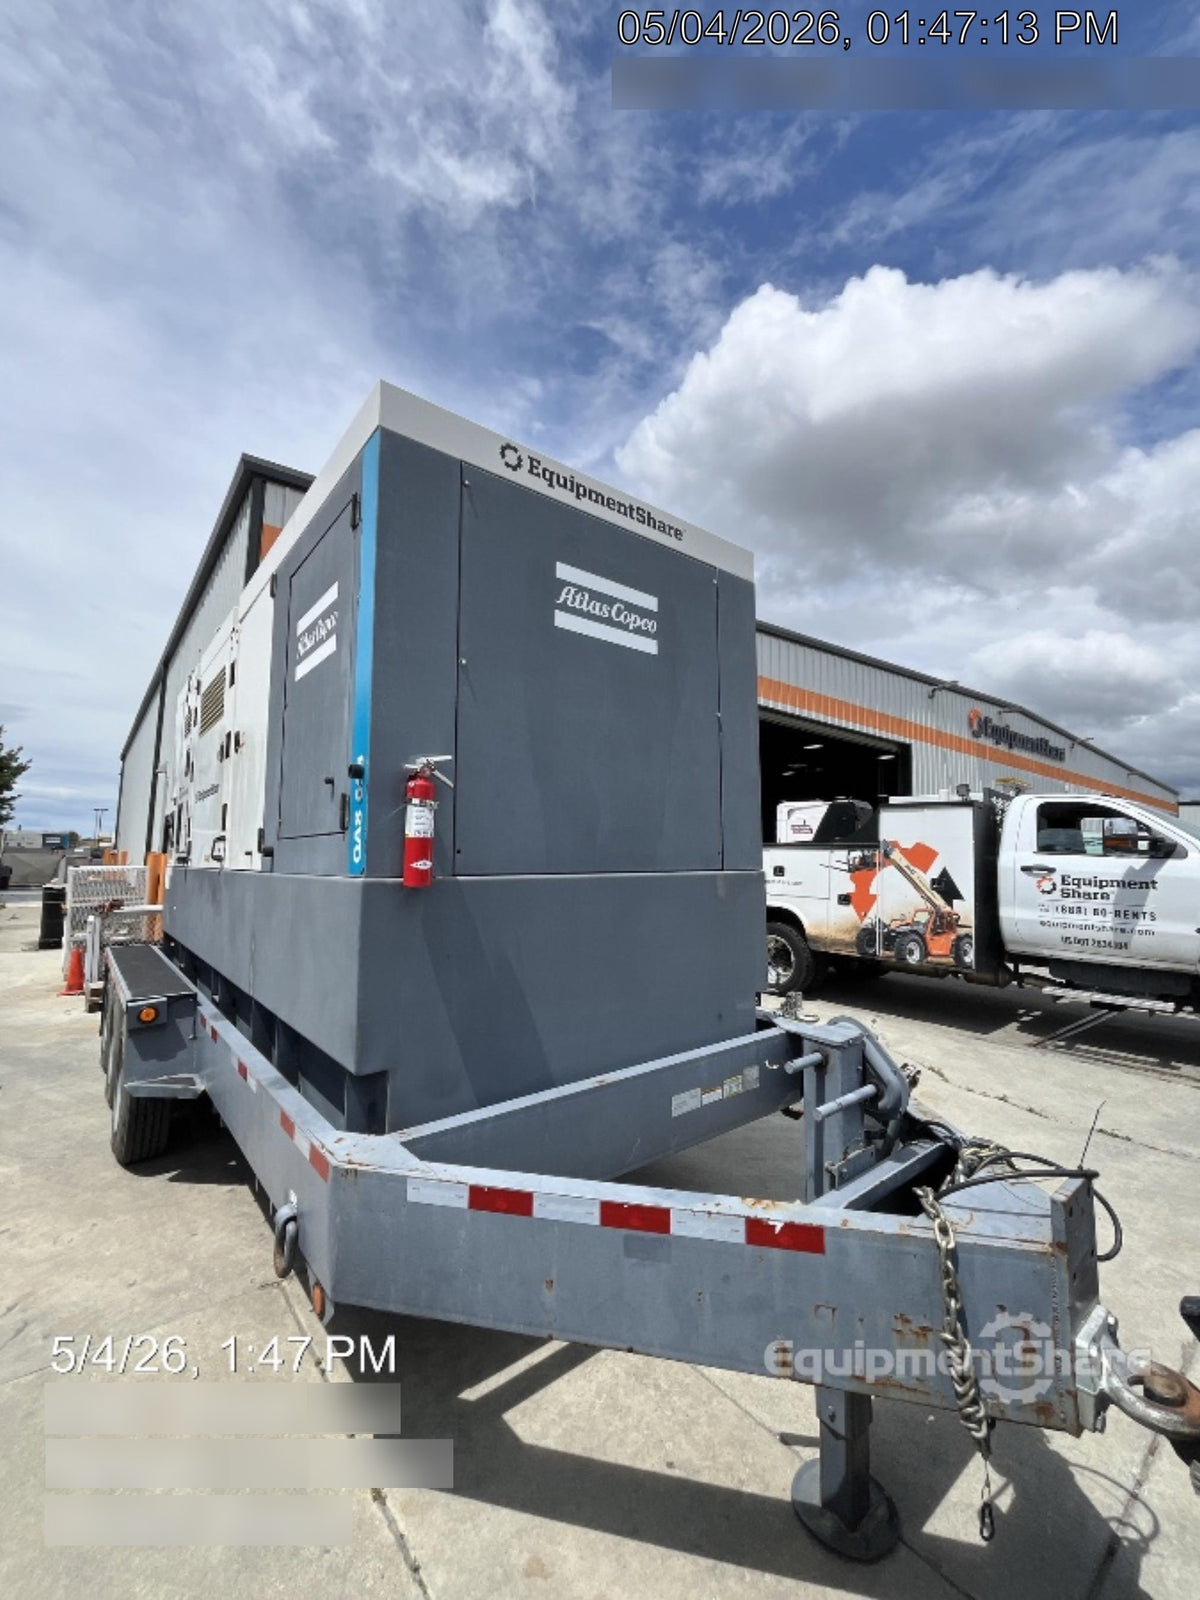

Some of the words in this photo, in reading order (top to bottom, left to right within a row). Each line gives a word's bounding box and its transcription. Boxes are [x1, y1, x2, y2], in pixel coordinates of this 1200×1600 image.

[527, 455, 684, 541] EquipmentShare
[1060, 874, 1159, 891] Equipment
[1060, 888, 1111, 901] Share
